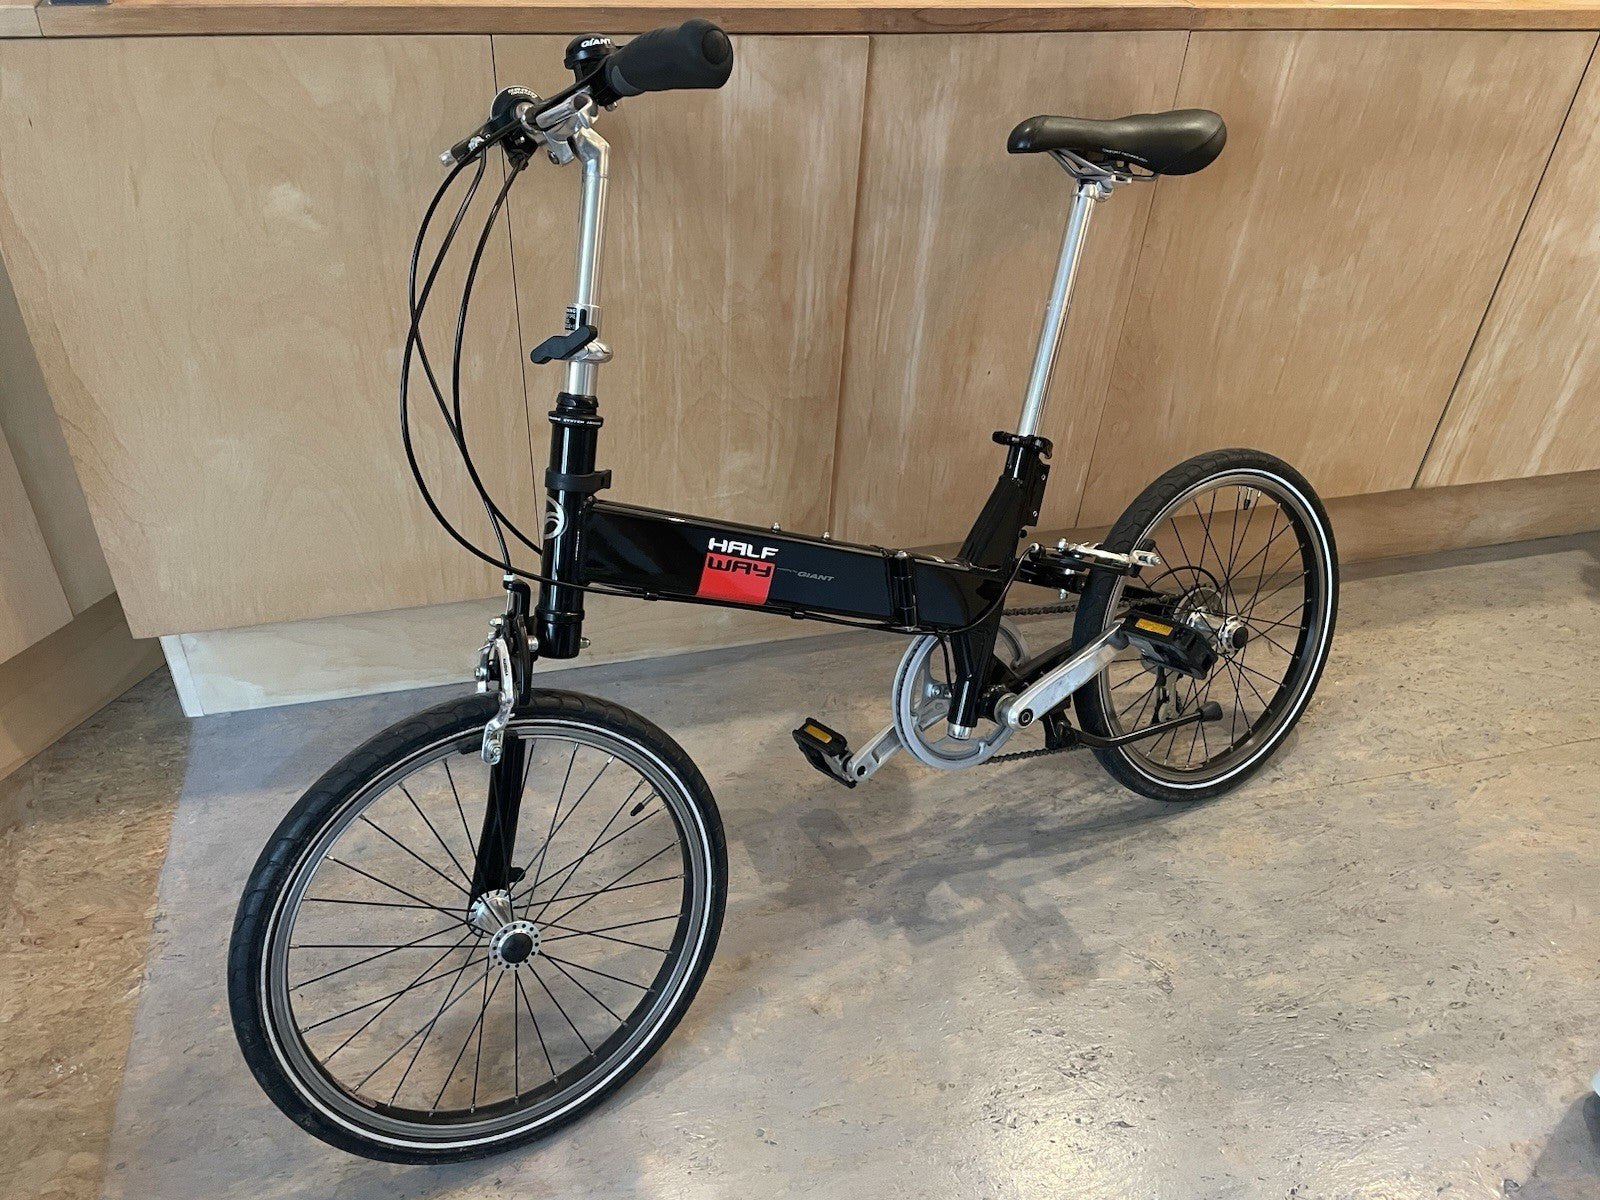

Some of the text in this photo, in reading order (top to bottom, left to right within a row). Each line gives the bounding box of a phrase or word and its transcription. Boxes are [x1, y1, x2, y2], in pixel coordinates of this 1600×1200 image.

[581, 38, 611, 48] GIANT
[708, 537, 779, 559] HALF
[707, 556, 772, 578] WAY
[797, 571, 835, 582] GIANT
